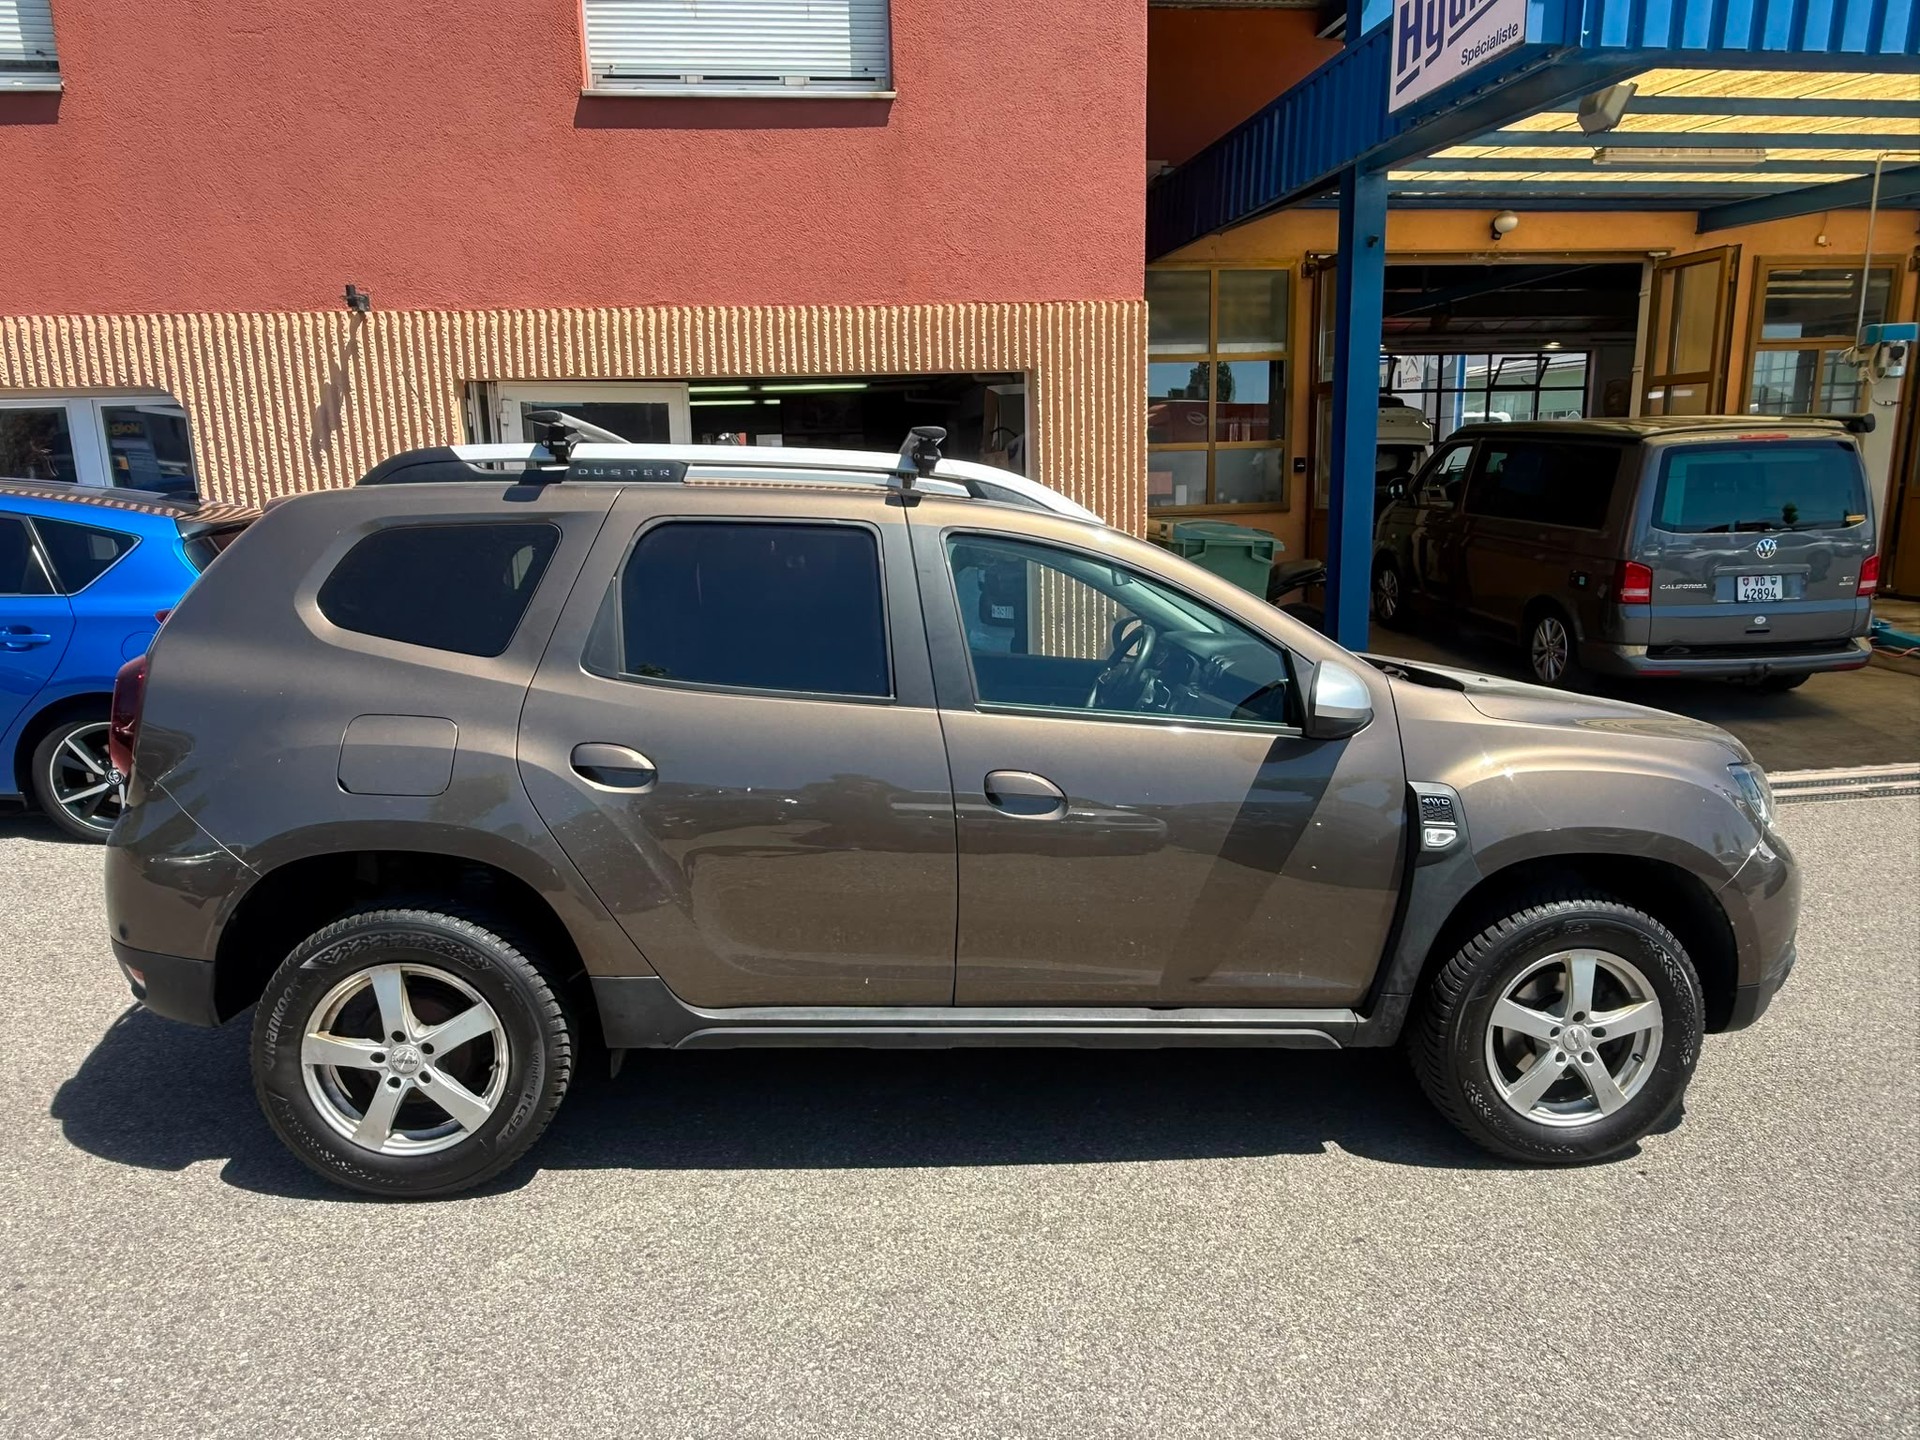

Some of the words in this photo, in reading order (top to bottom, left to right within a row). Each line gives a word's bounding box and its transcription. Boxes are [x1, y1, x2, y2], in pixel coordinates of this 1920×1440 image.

[1460, 22, 1519, 66] Spécialiste
[577, 468, 671, 477] DUSTER
[1754, 576, 1766, 587] VD
[1743, 587, 1777, 600] 42894
